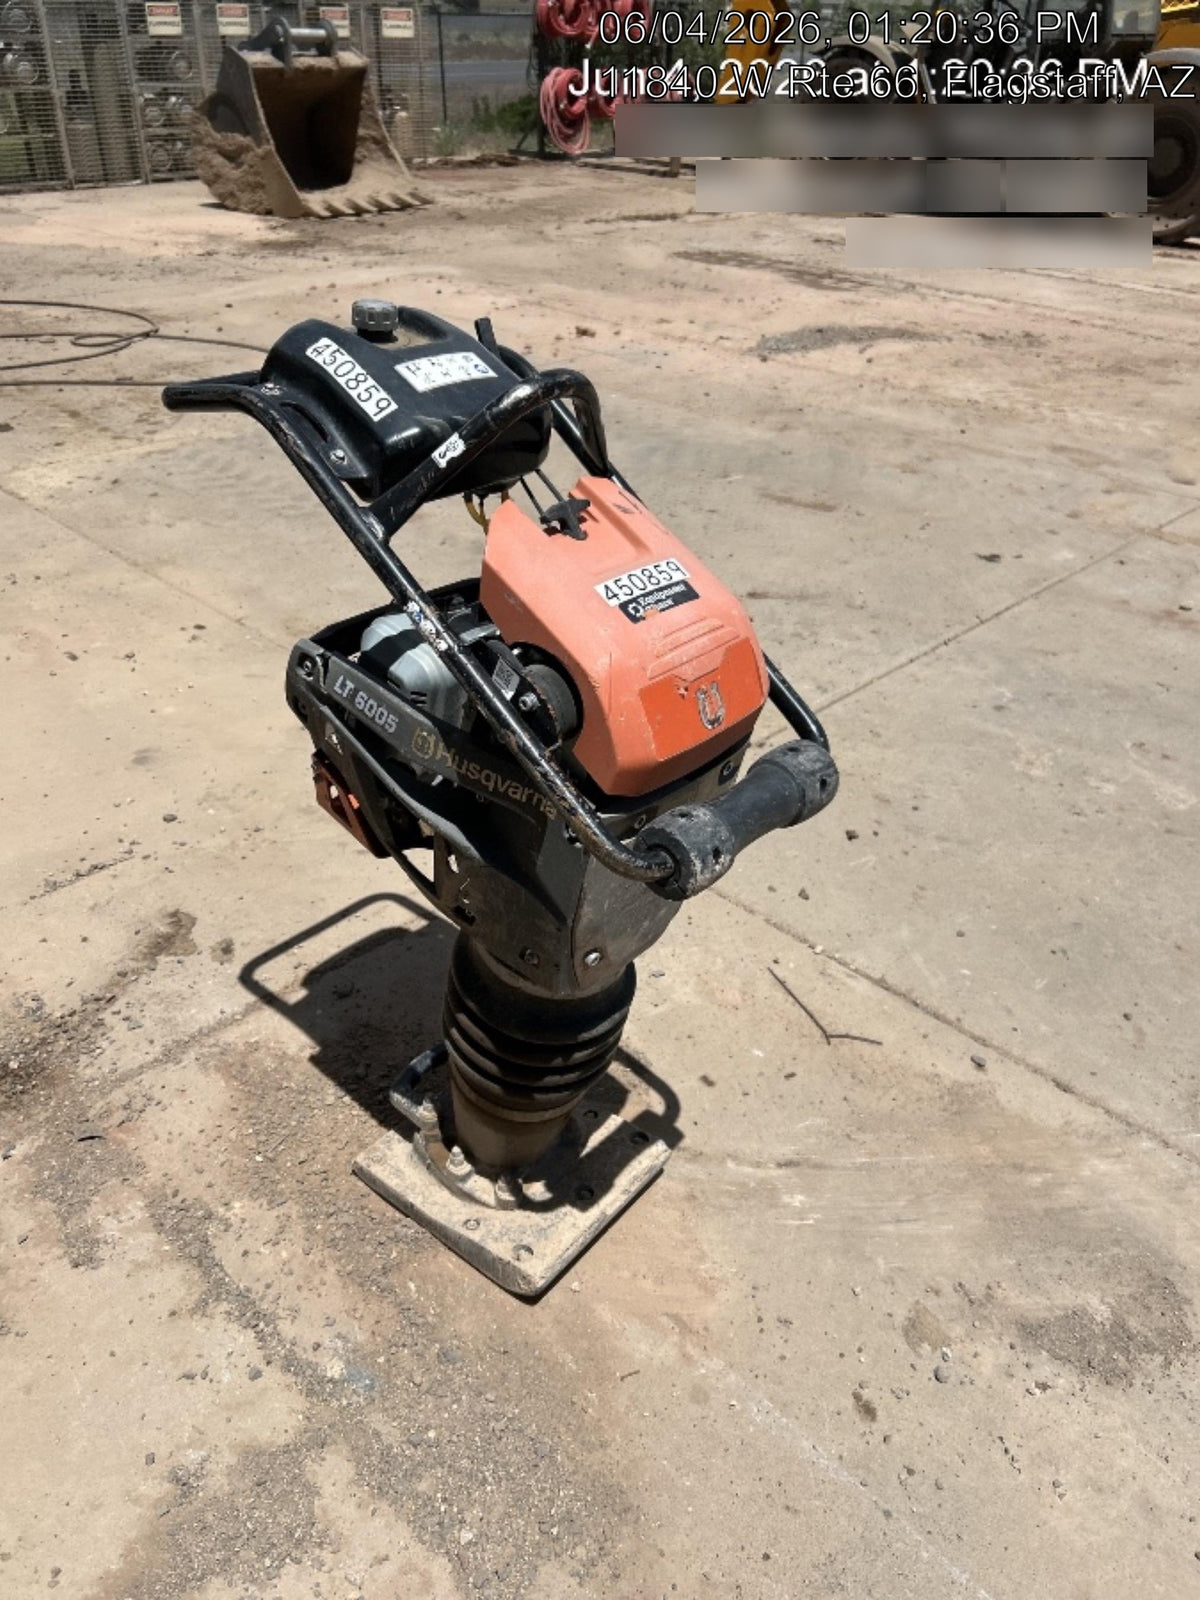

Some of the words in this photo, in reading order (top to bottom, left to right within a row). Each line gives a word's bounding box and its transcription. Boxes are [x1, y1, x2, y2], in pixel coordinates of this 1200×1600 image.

[309, 342, 392, 417] 450859
[603, 560, 687, 602] 450859
[333, 675, 355, 698] LT
[355, 690, 399, 733] 6005
